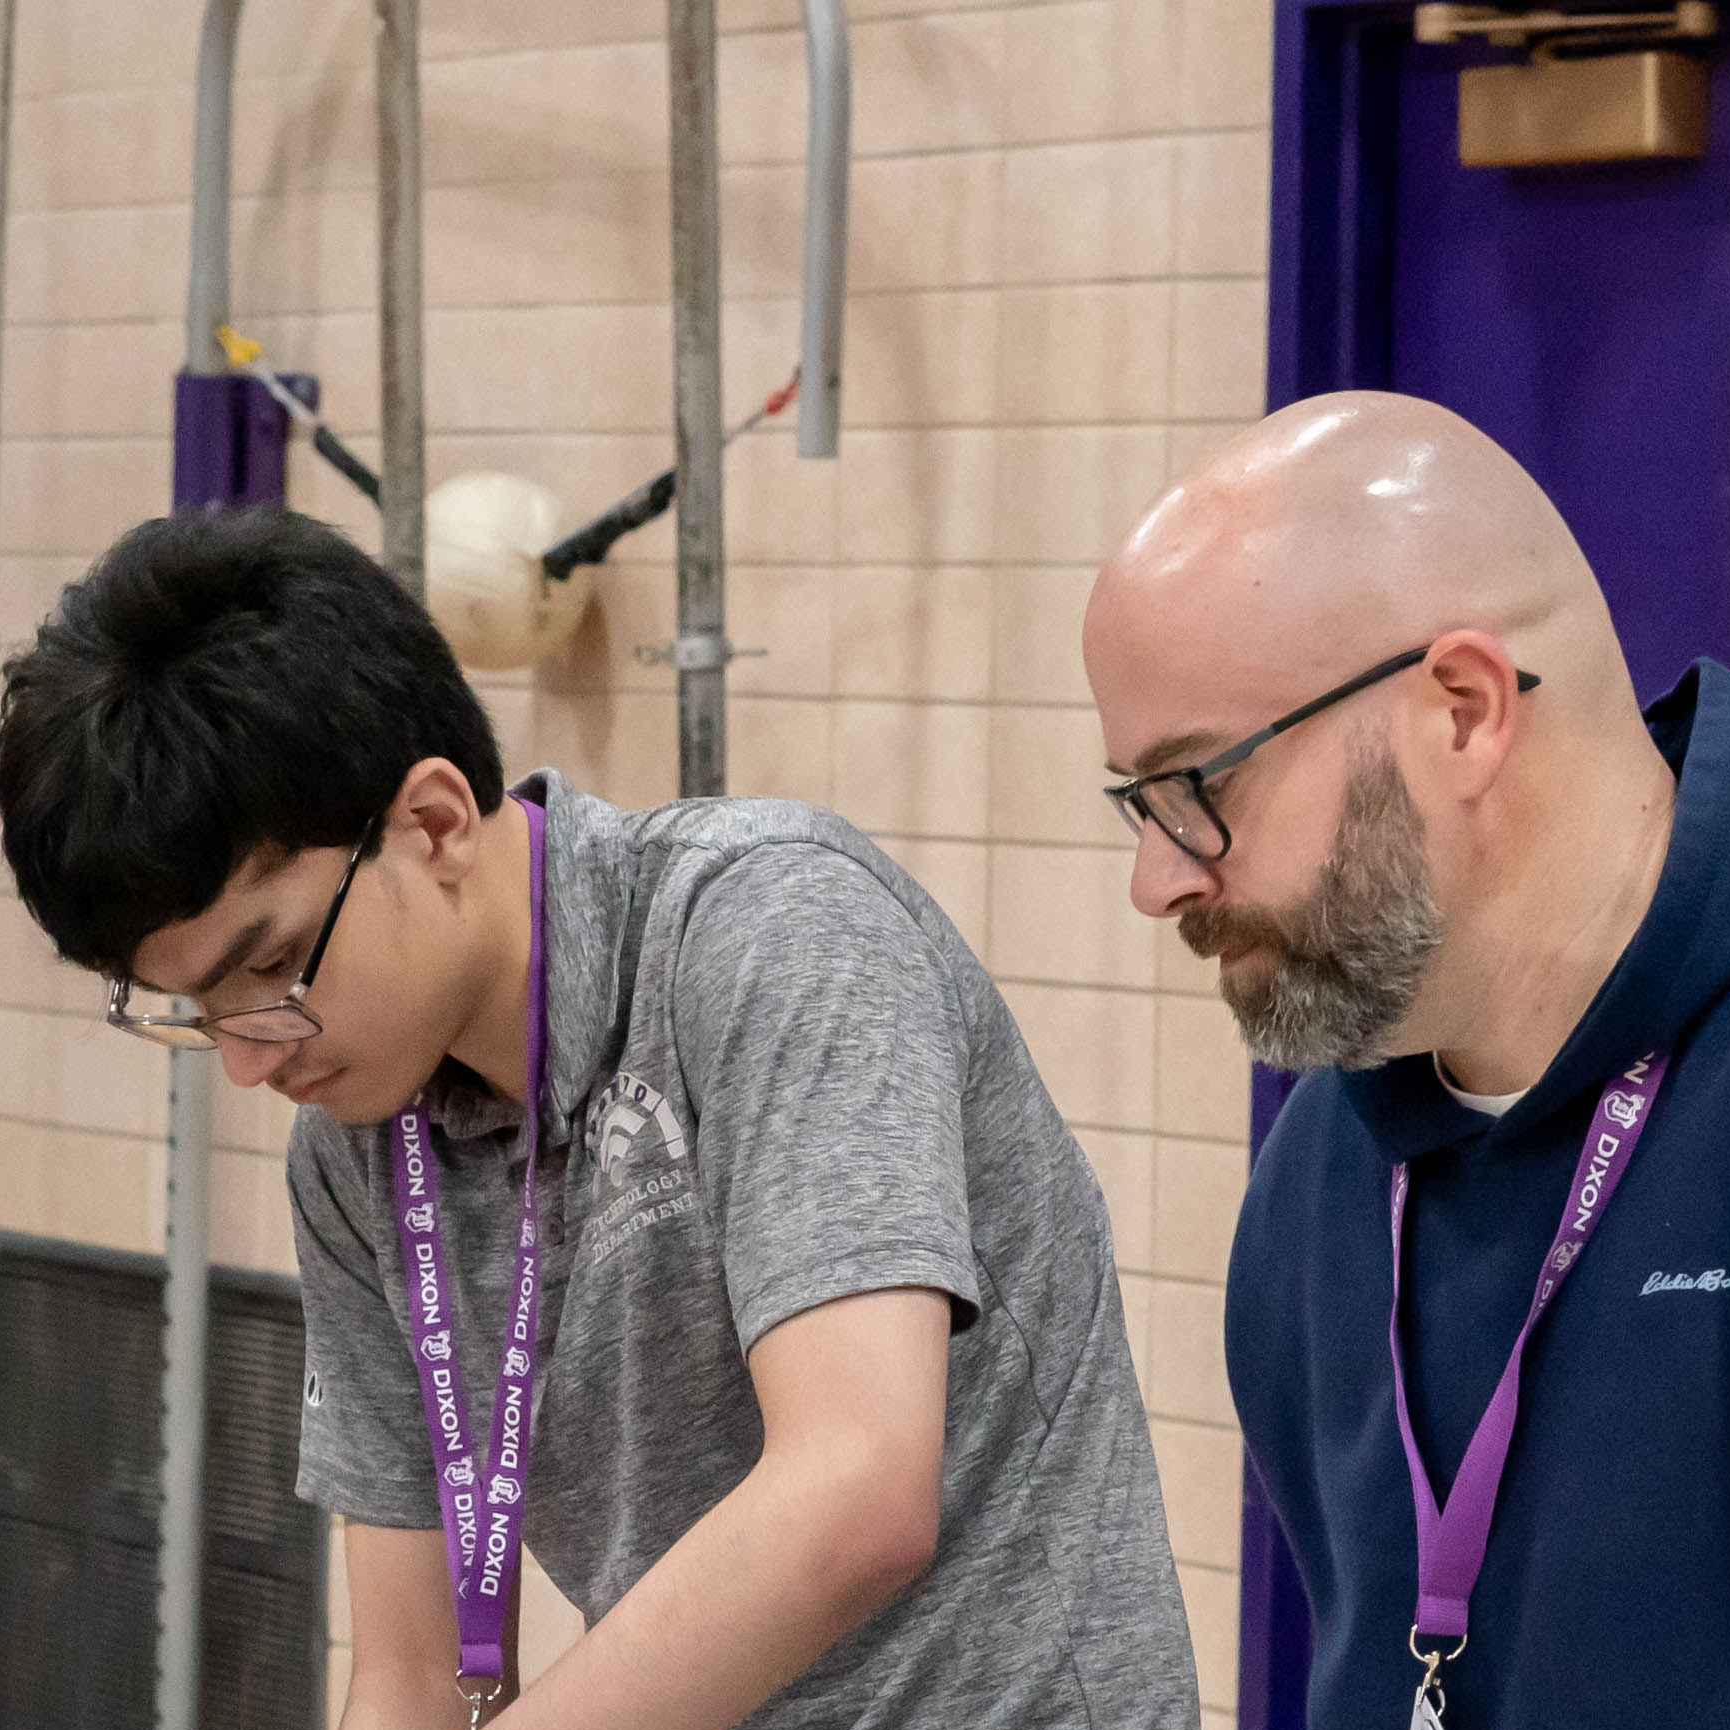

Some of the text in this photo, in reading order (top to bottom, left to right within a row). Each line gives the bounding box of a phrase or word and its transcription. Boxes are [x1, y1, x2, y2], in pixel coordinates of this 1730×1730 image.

[401, 1114, 425, 1197] DIXON
[1573, 1132, 1620, 1232] DIXON
[415, 1243, 441, 1325] DIXON
[514, 1256, 535, 1341] DIXON
[433, 1368, 463, 1452] DIXON
[500, 1384, 523, 1469] DIXON
[479, 1512, 510, 1597] DIXON
